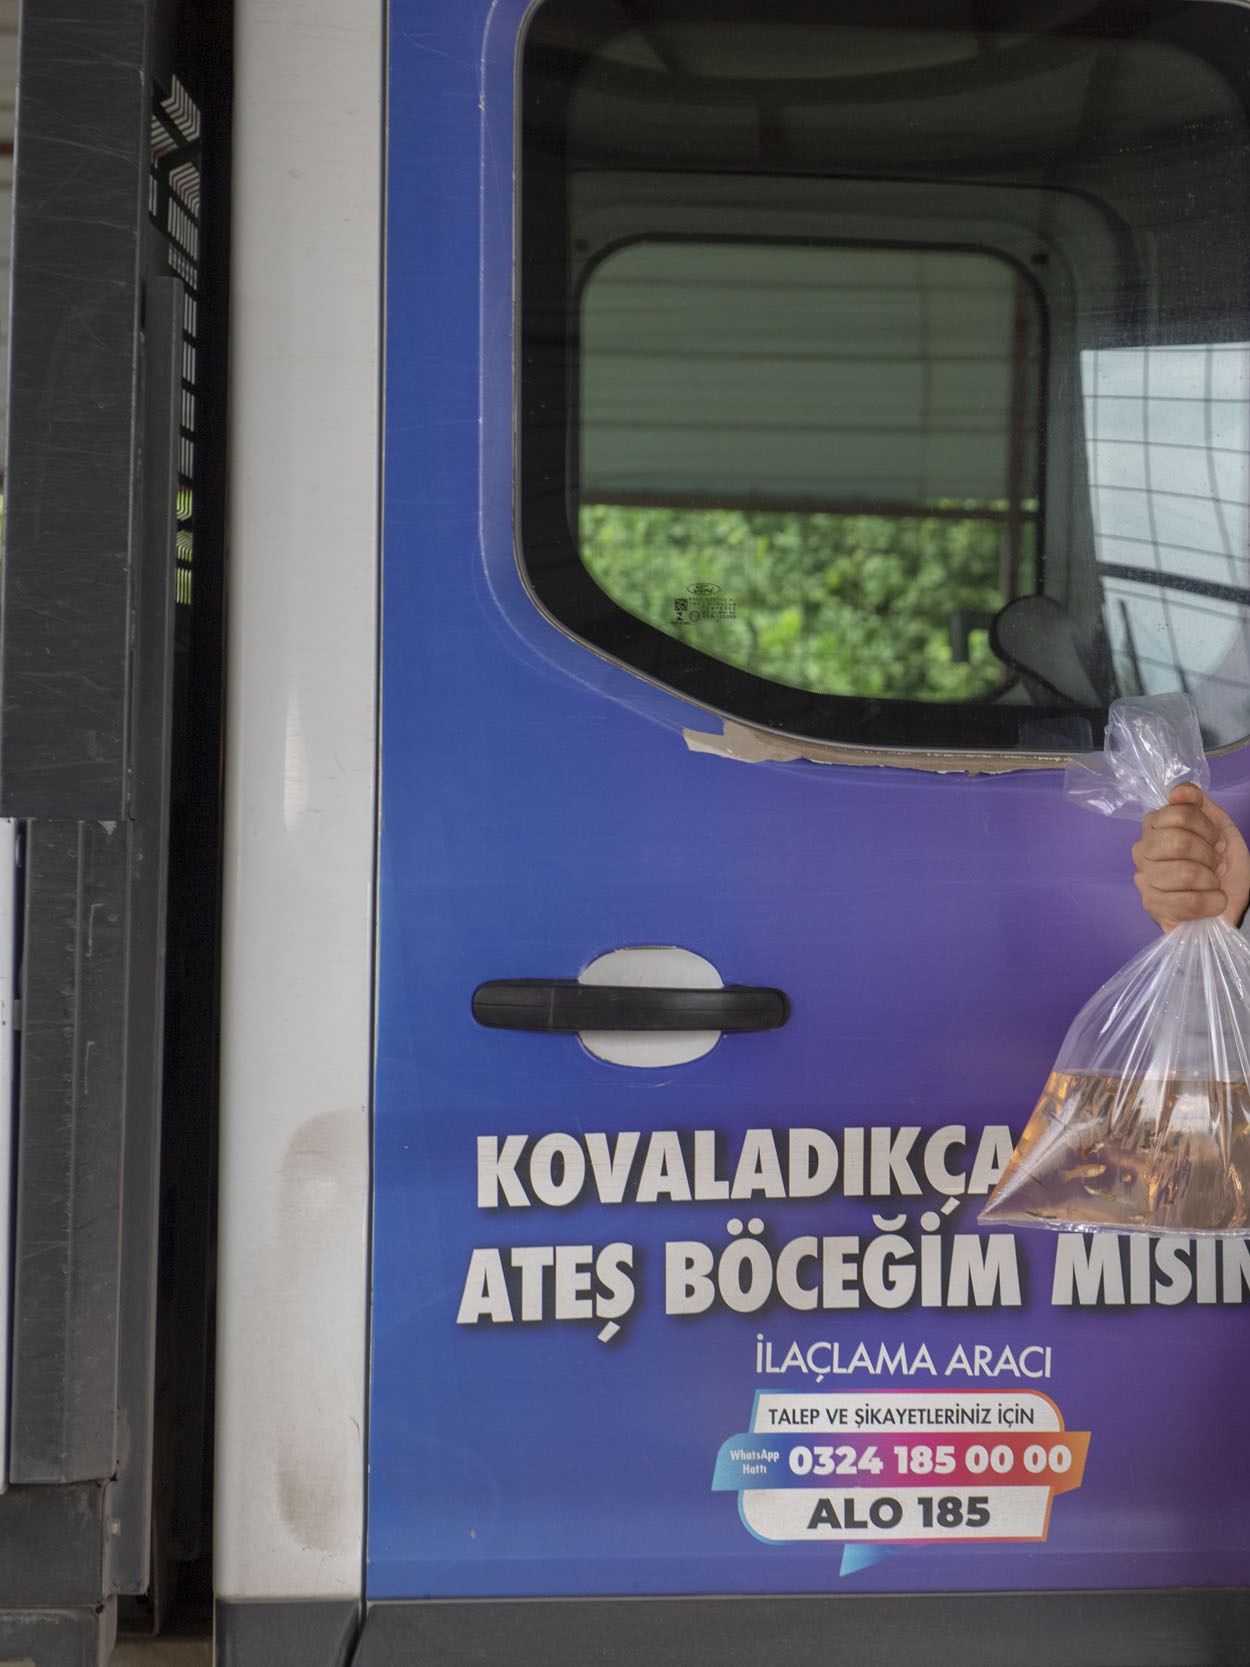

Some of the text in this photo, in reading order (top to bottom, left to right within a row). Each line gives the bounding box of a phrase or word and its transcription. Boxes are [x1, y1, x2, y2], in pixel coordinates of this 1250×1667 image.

[477, 1125, 1017, 1215] KOVALADIKÇA
[456, 1243, 636, 1343] ATEŞ
[665, 1212, 1022, 1314] BÖCEĞİM
[756, 1334, 1052, 1383] İLAÇLAMA ARACI
[769, 1403, 1035, 1428] TALEP VE ŞİKAYETLERİNİZ İÇİN
[730, 1448, 780, 1463] WhatsApp
[788, 1445, 1073, 1475] 0324 185 00 00
[807, 1496, 991, 1529] ALO 185
